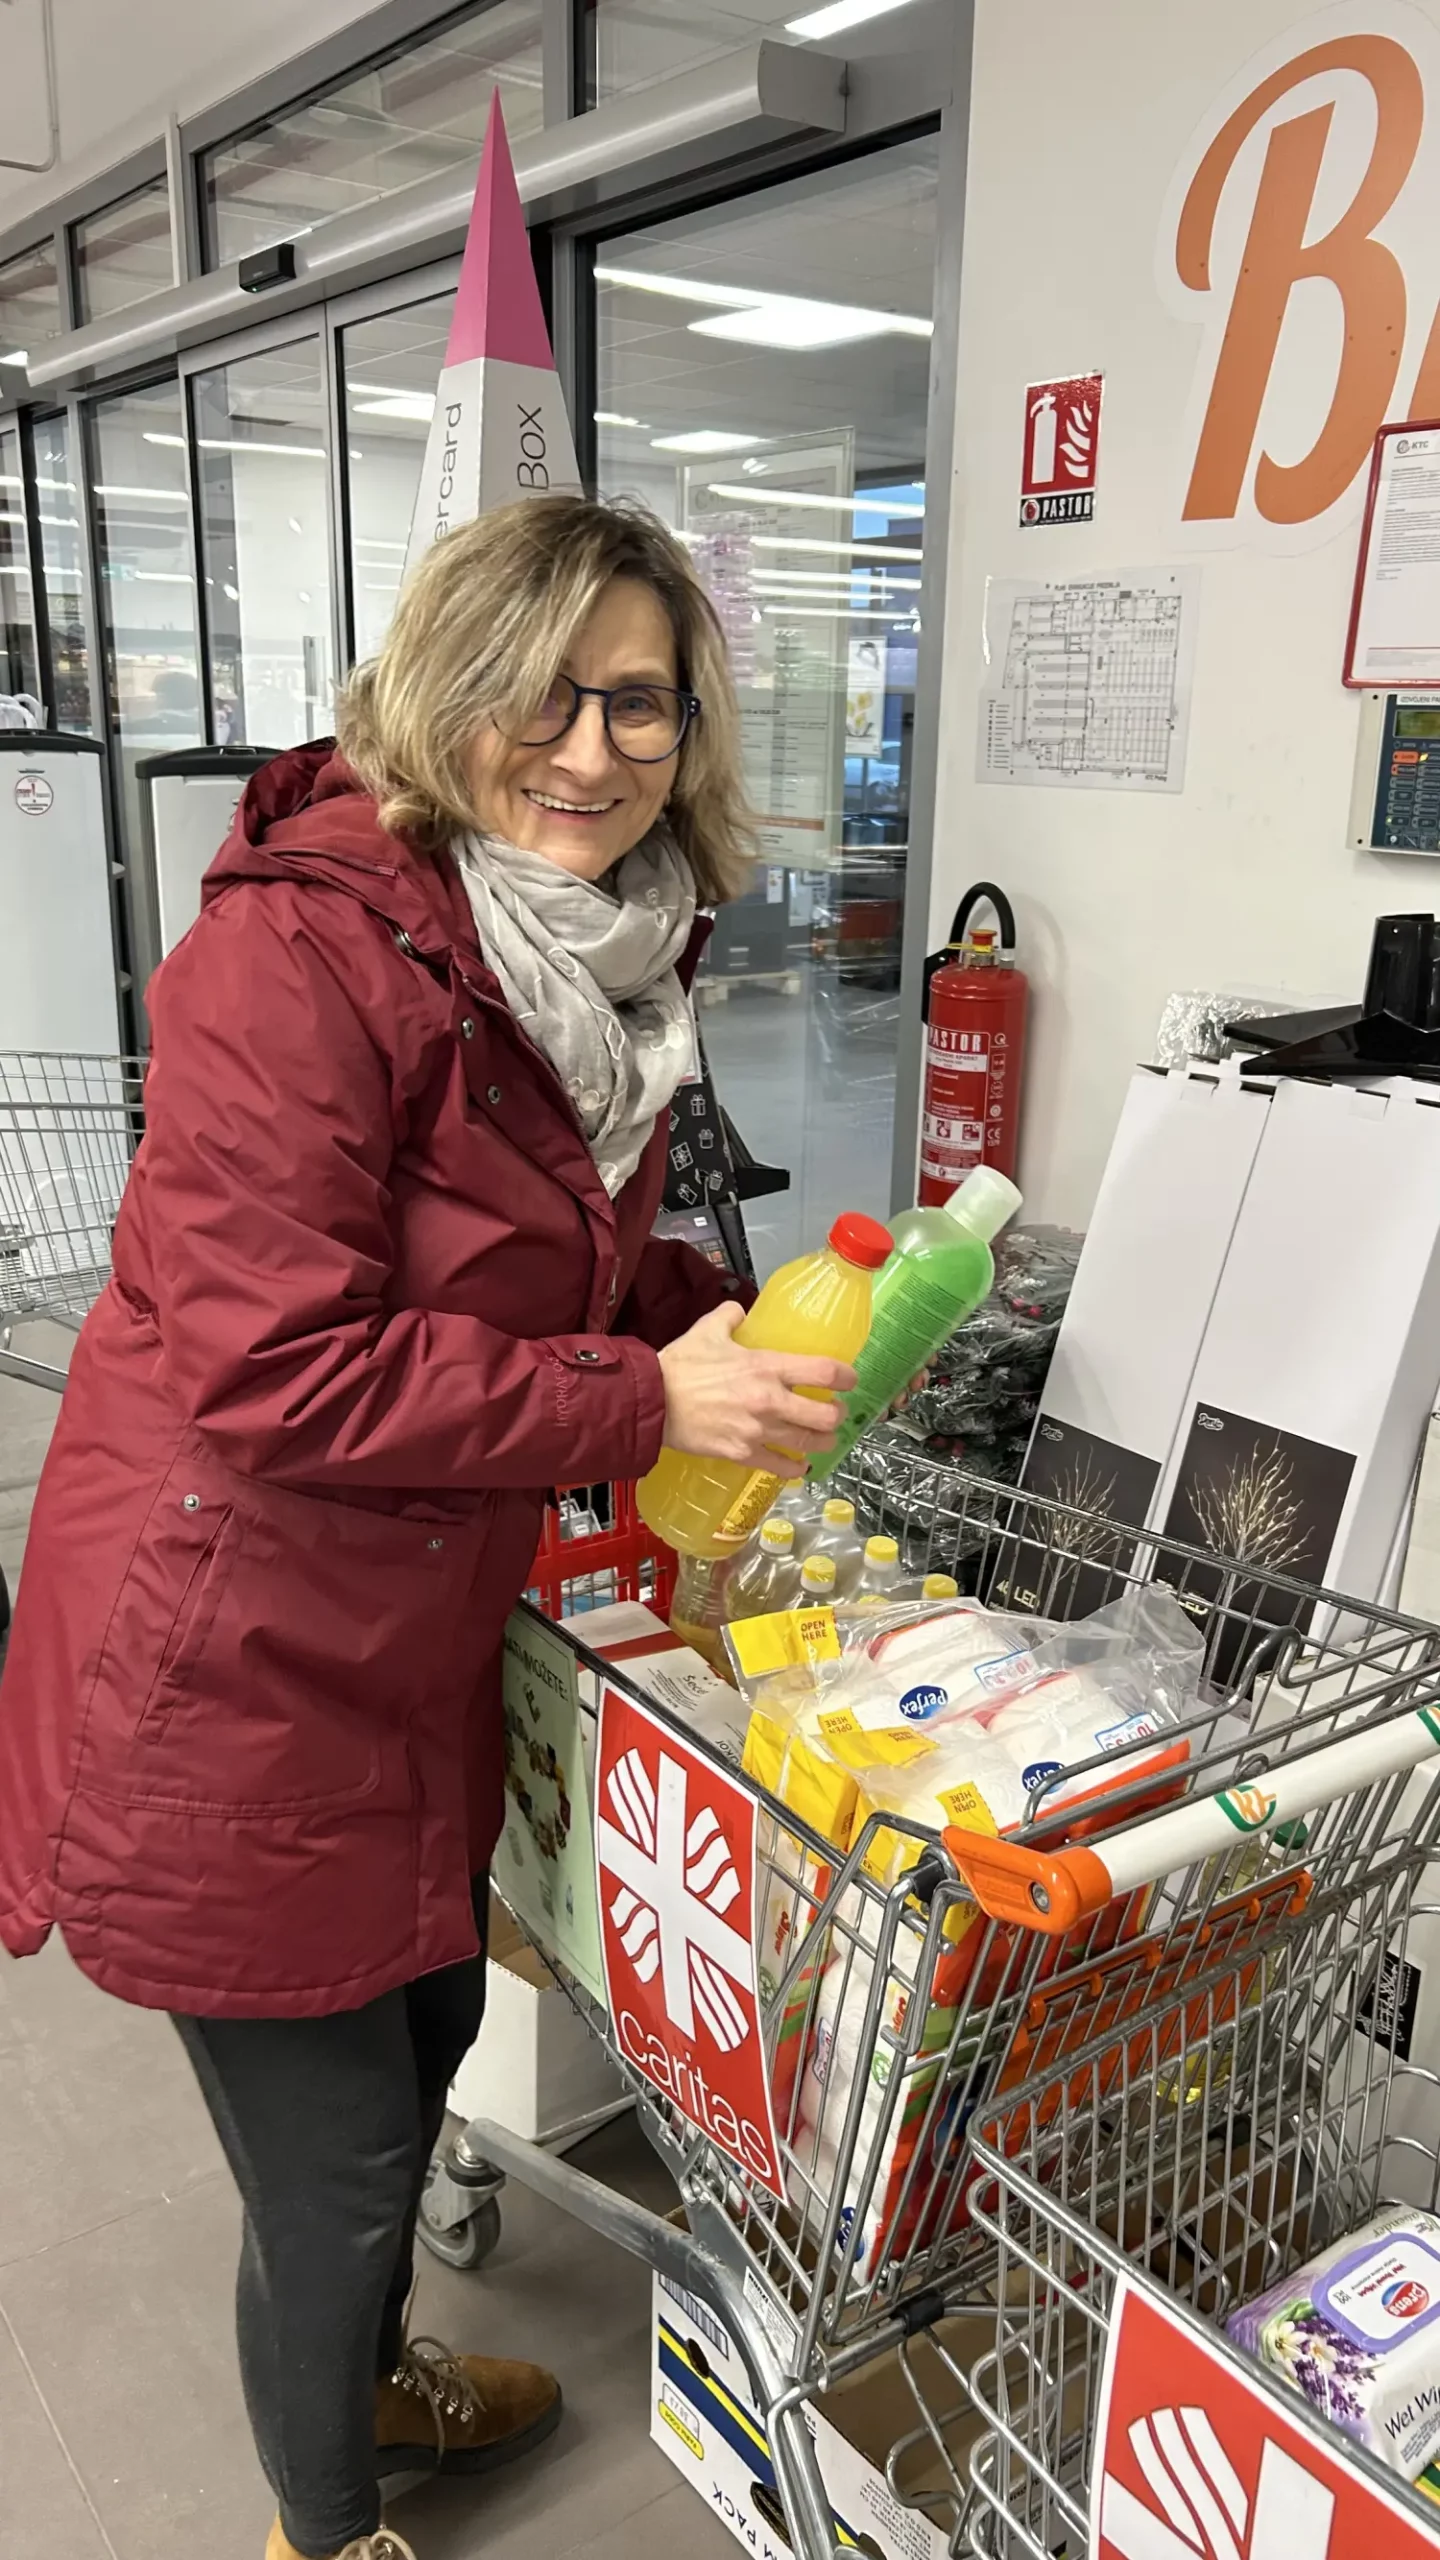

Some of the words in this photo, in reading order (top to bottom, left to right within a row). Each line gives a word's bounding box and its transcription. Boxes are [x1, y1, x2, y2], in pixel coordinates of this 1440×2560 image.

[1176, 34, 1440, 524] B
[1042, 495, 1091, 518] PASTOR
[801, 1619, 826, 1632] OPEN
[802, 1629, 828, 1641] HERE
[901, 1689, 948, 1716] Perfex
[824, 1716, 849, 1728] HERE
[828, 1723, 853, 1734] OPEN
[948, 1790, 973, 1804] HERE
[953, 1800, 977, 1814] OPEN
[1384, 2403, 1415, 2440] Wet
[1414, 2386, 1440, 2413] Wi
[713, 2480, 756, 2547] PACK
